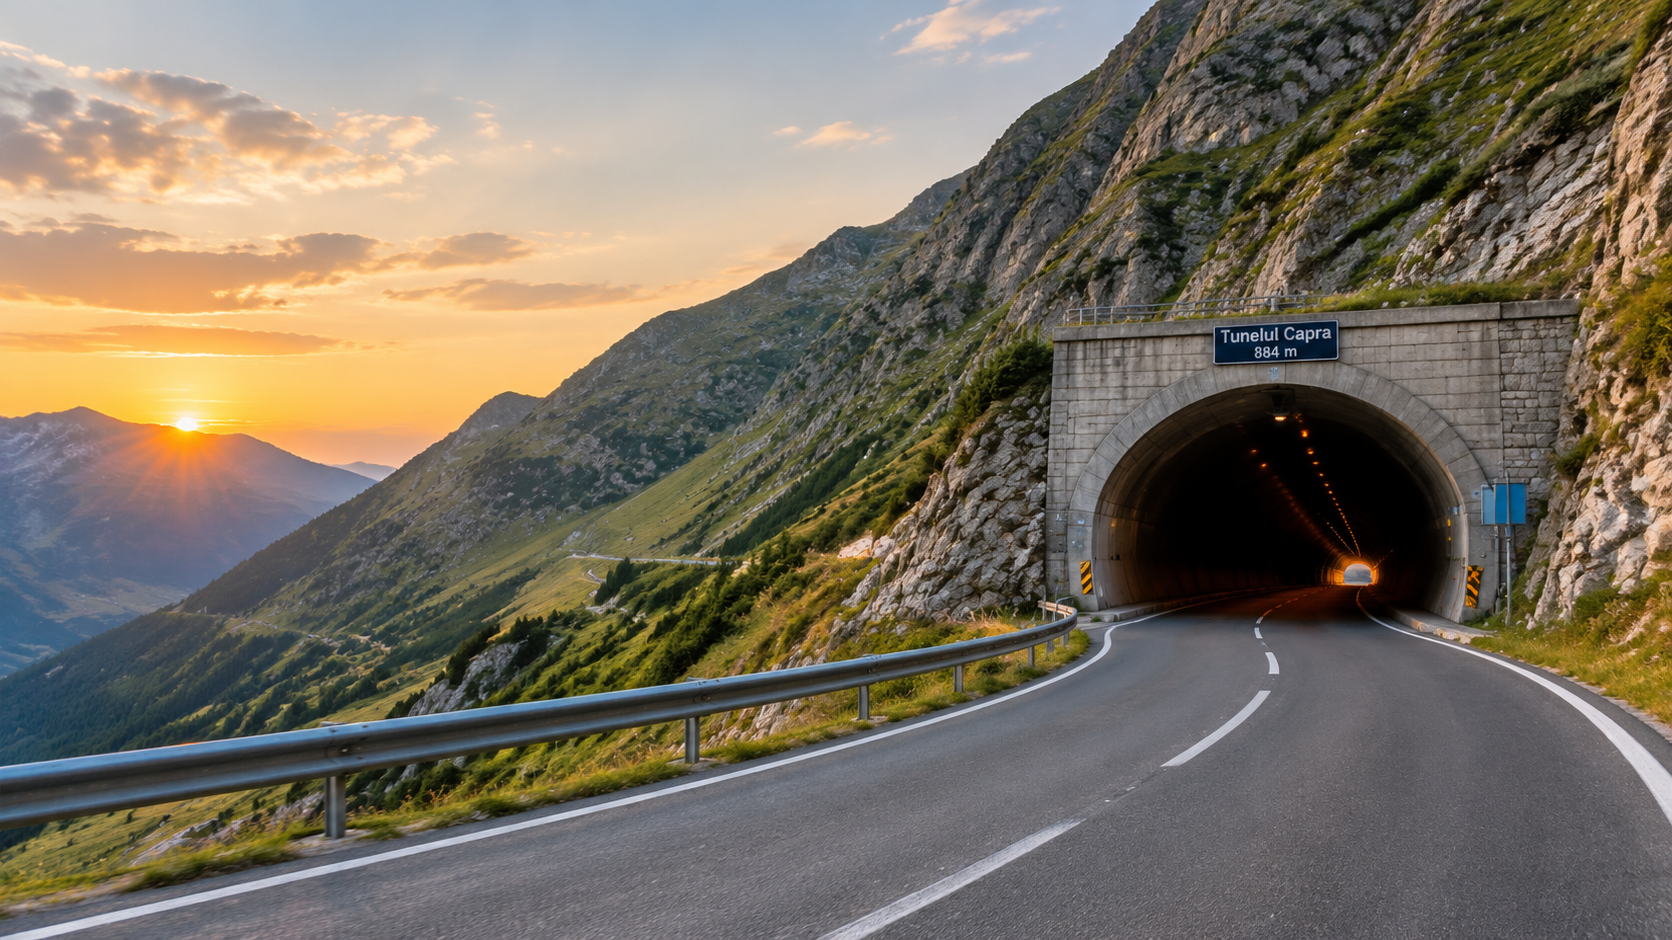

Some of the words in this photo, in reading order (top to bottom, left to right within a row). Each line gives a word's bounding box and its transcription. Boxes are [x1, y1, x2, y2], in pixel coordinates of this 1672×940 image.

[1221, 327, 1279, 343] Tunelul
[1284, 326, 1332, 343] Capra
[1254, 346, 1280, 359] 884
[1284, 347, 1297, 358] m
